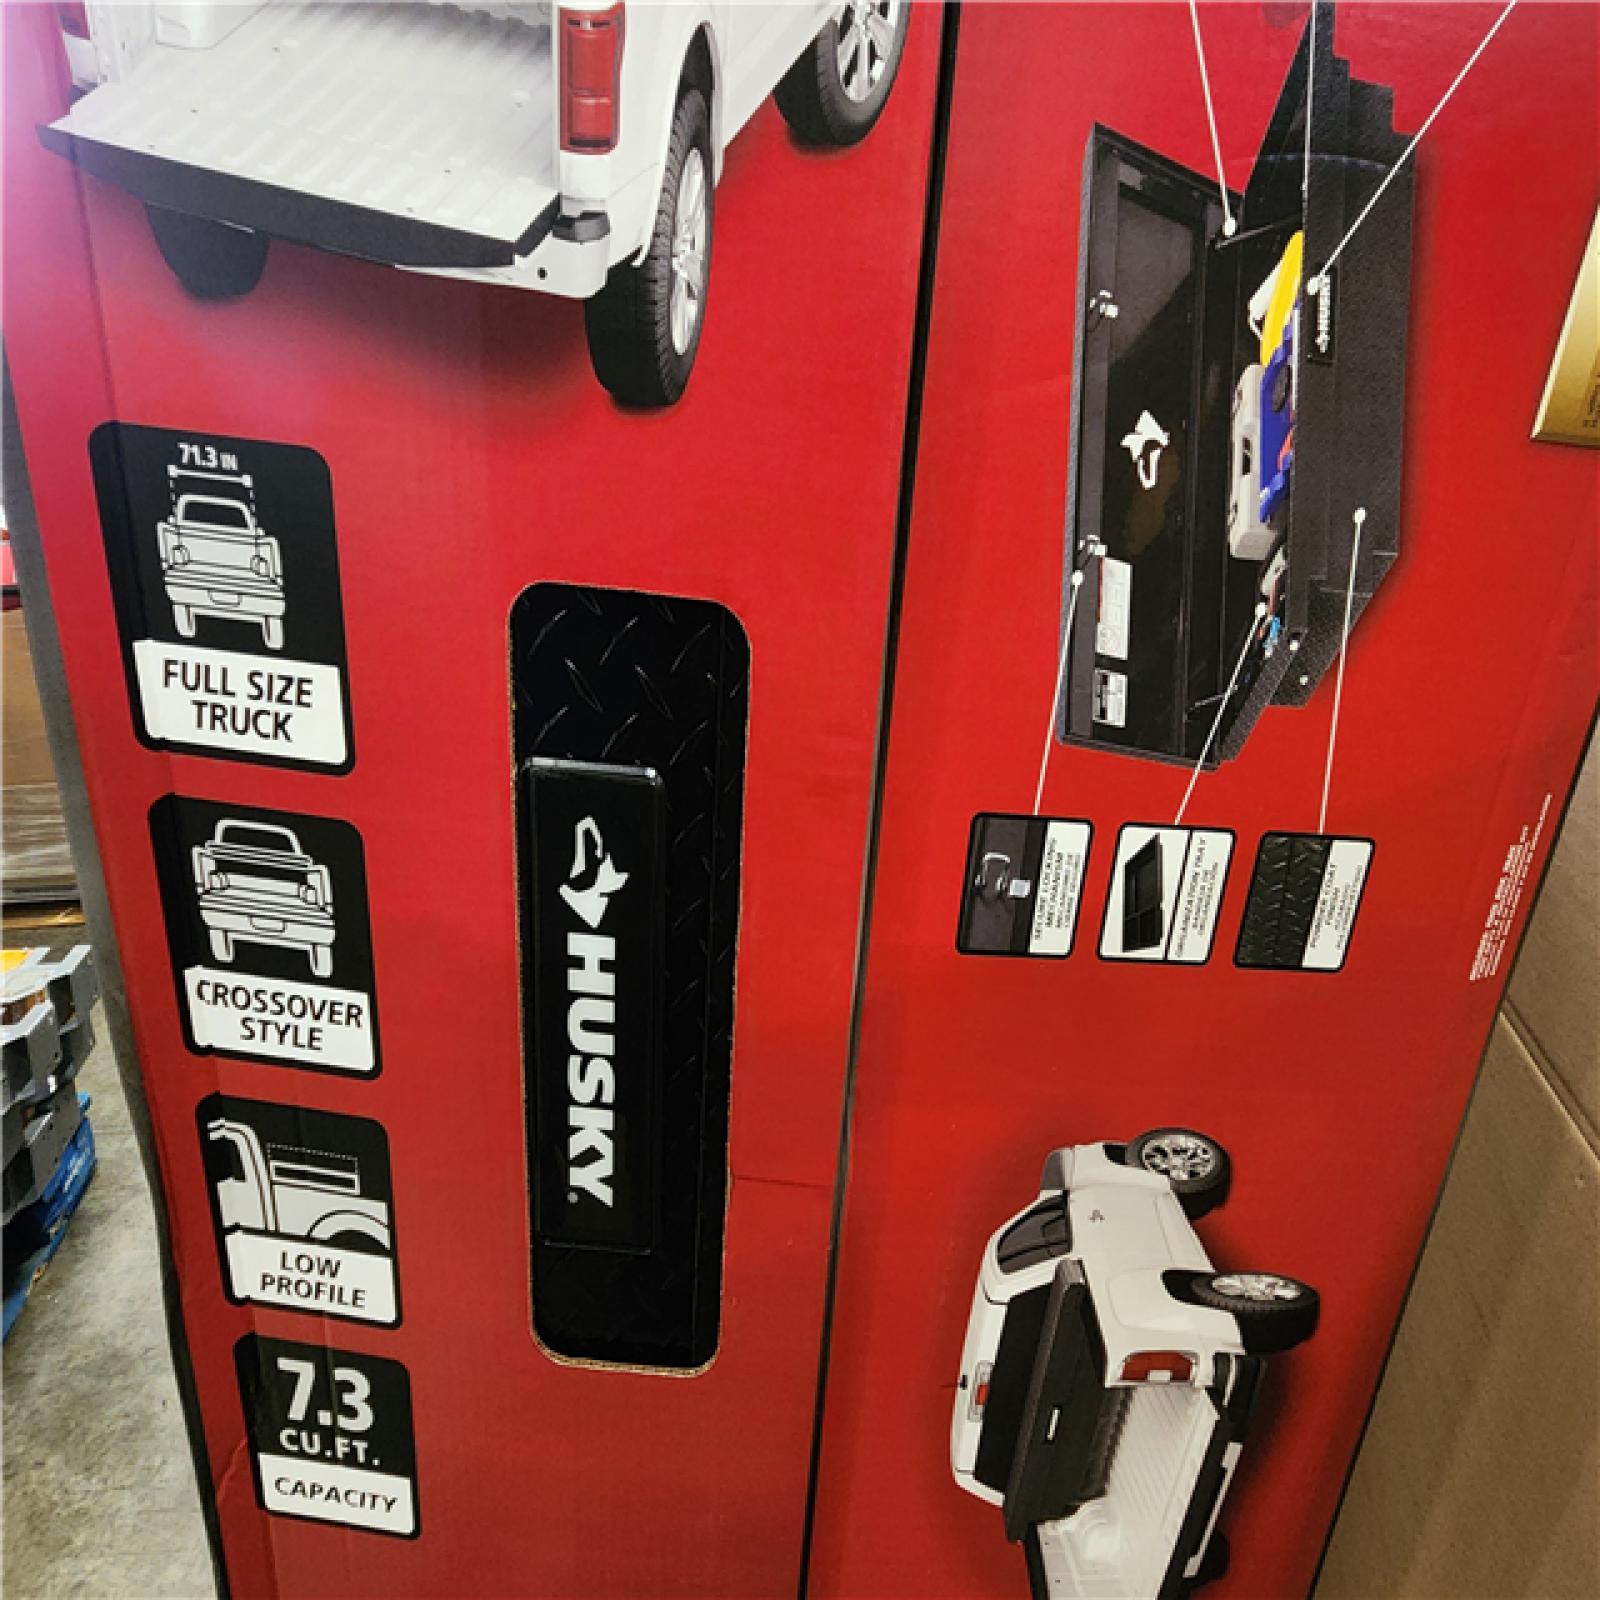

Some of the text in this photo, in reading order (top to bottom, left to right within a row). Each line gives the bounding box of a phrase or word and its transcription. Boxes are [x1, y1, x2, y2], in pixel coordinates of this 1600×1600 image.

[178, 441, 239, 471] 71.3 IN
[163, 659, 314, 708] FULL SIZE
[191, 699, 293, 743] TRUCK
[196, 979, 363, 1029] CROSSOVER
[239, 1017, 323, 1051] STYLE
[567, 932, 616, 1208] HUSKY
[280, 1252, 341, 1278] LOW
[260, 1272, 366, 1308] PROFILE
[276, 1357, 375, 1432] 7.3
[279, 1428, 381, 1466] CU.FT.
[274, 1476, 399, 1513] CAPACITY
